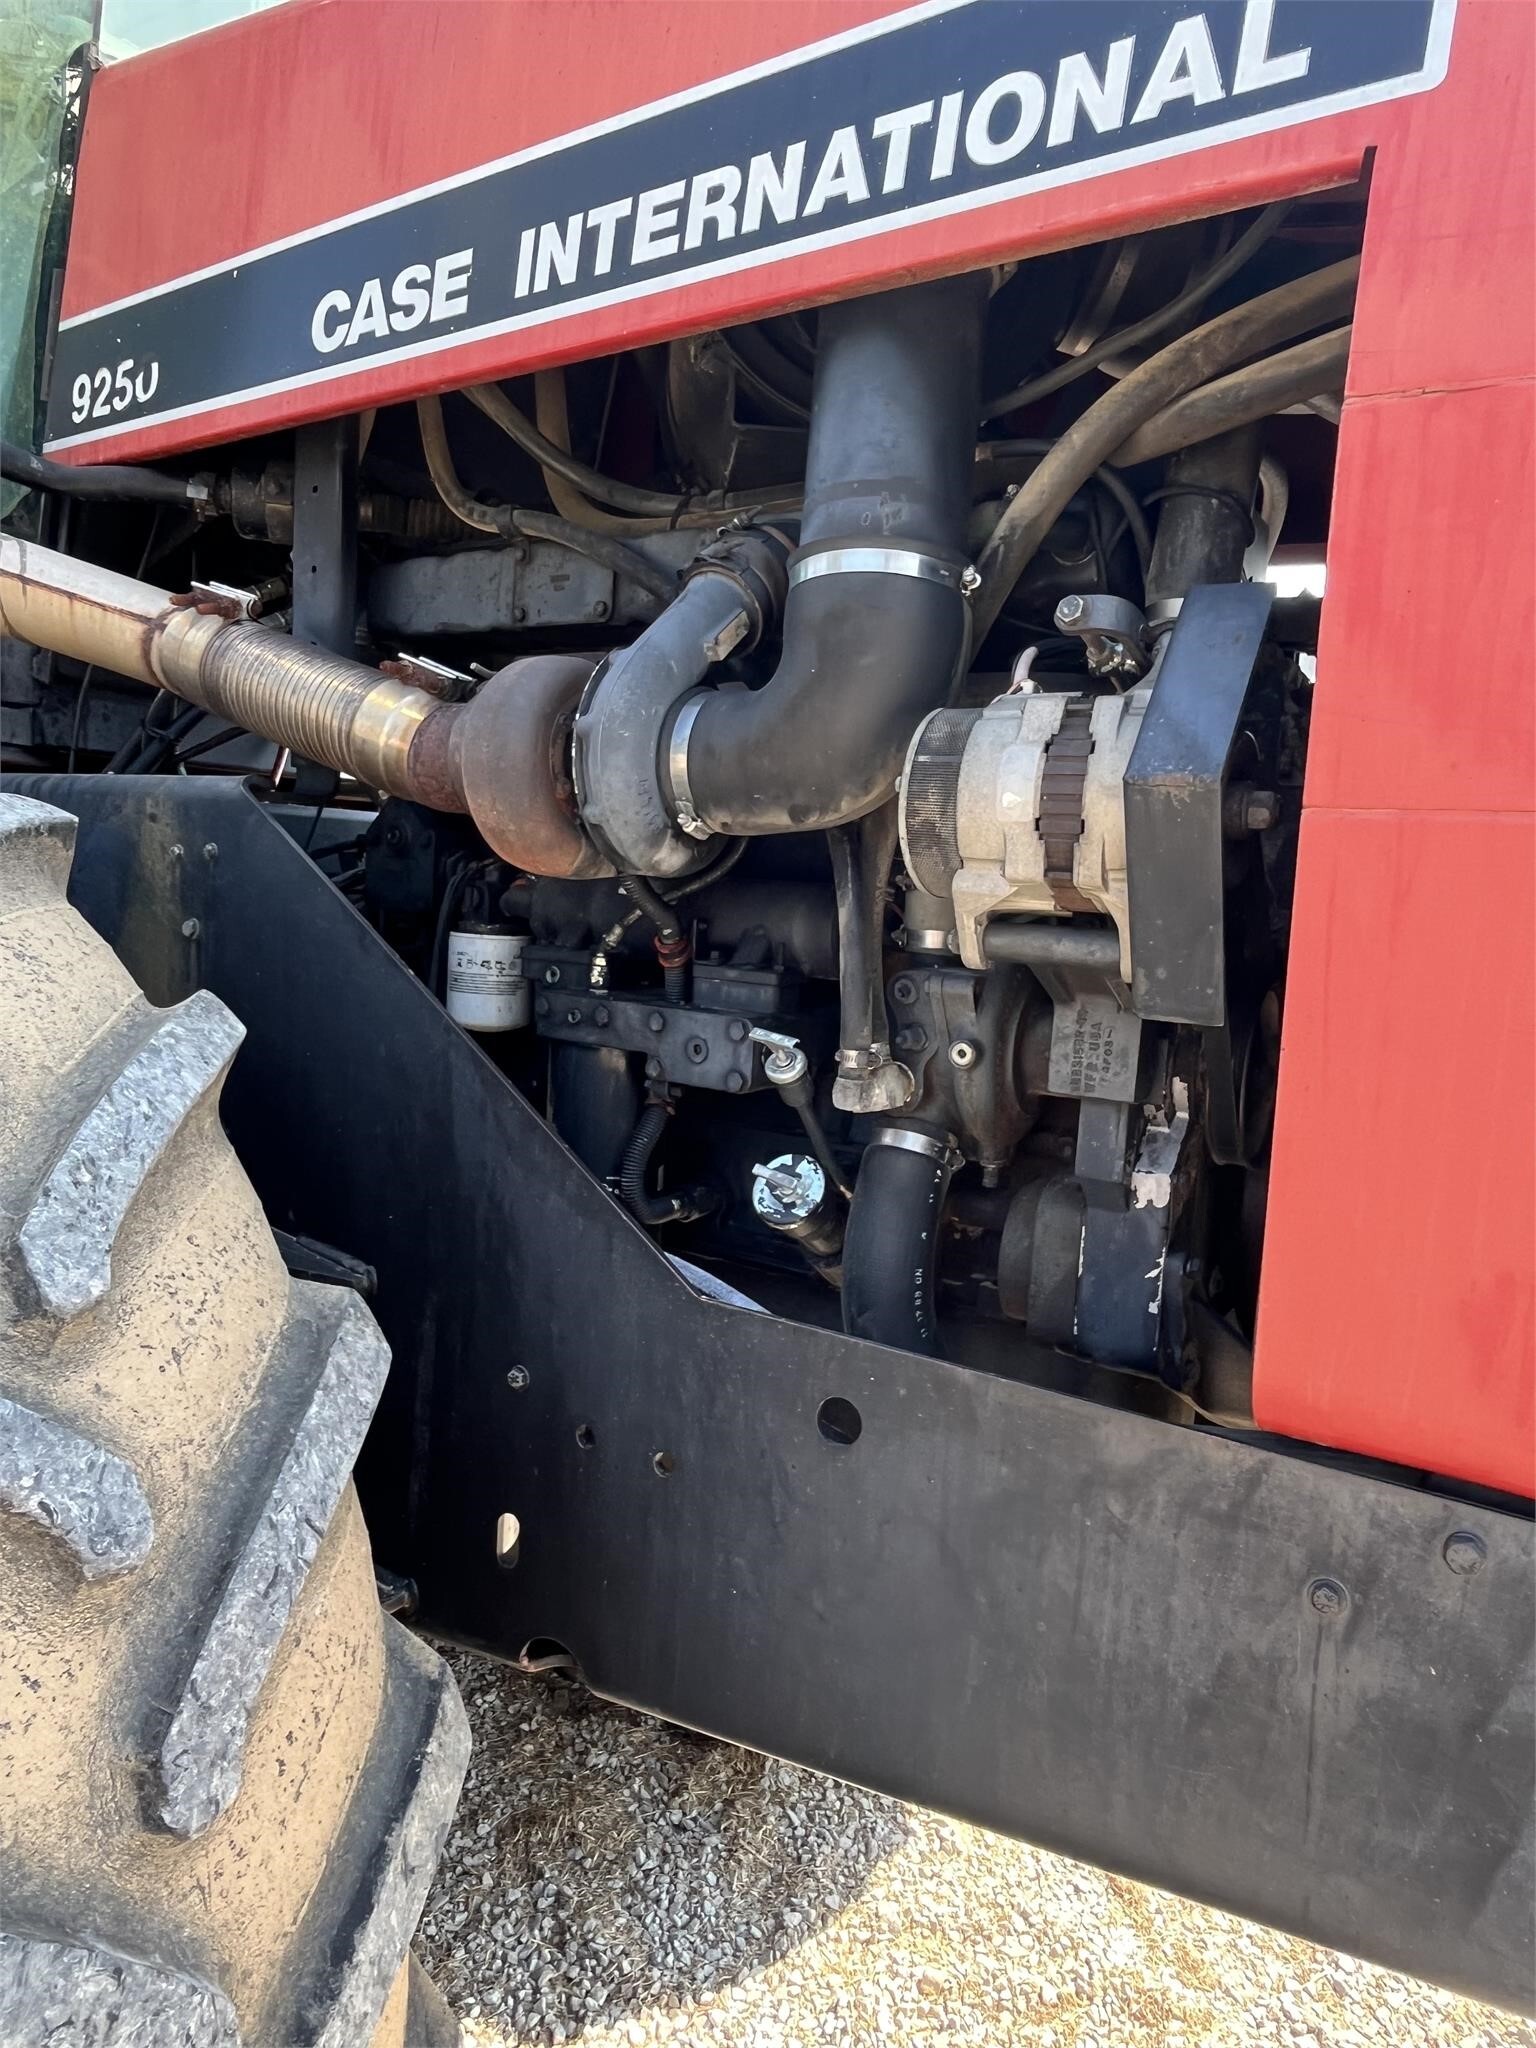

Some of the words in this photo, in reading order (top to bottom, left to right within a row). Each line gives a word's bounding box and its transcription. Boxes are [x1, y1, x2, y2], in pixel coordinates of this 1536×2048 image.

[311, 247, 474, 353] CASE
[514, 0, 1312, 299] INTERNATIONAL
[71, 358, 159, 424] 9250
